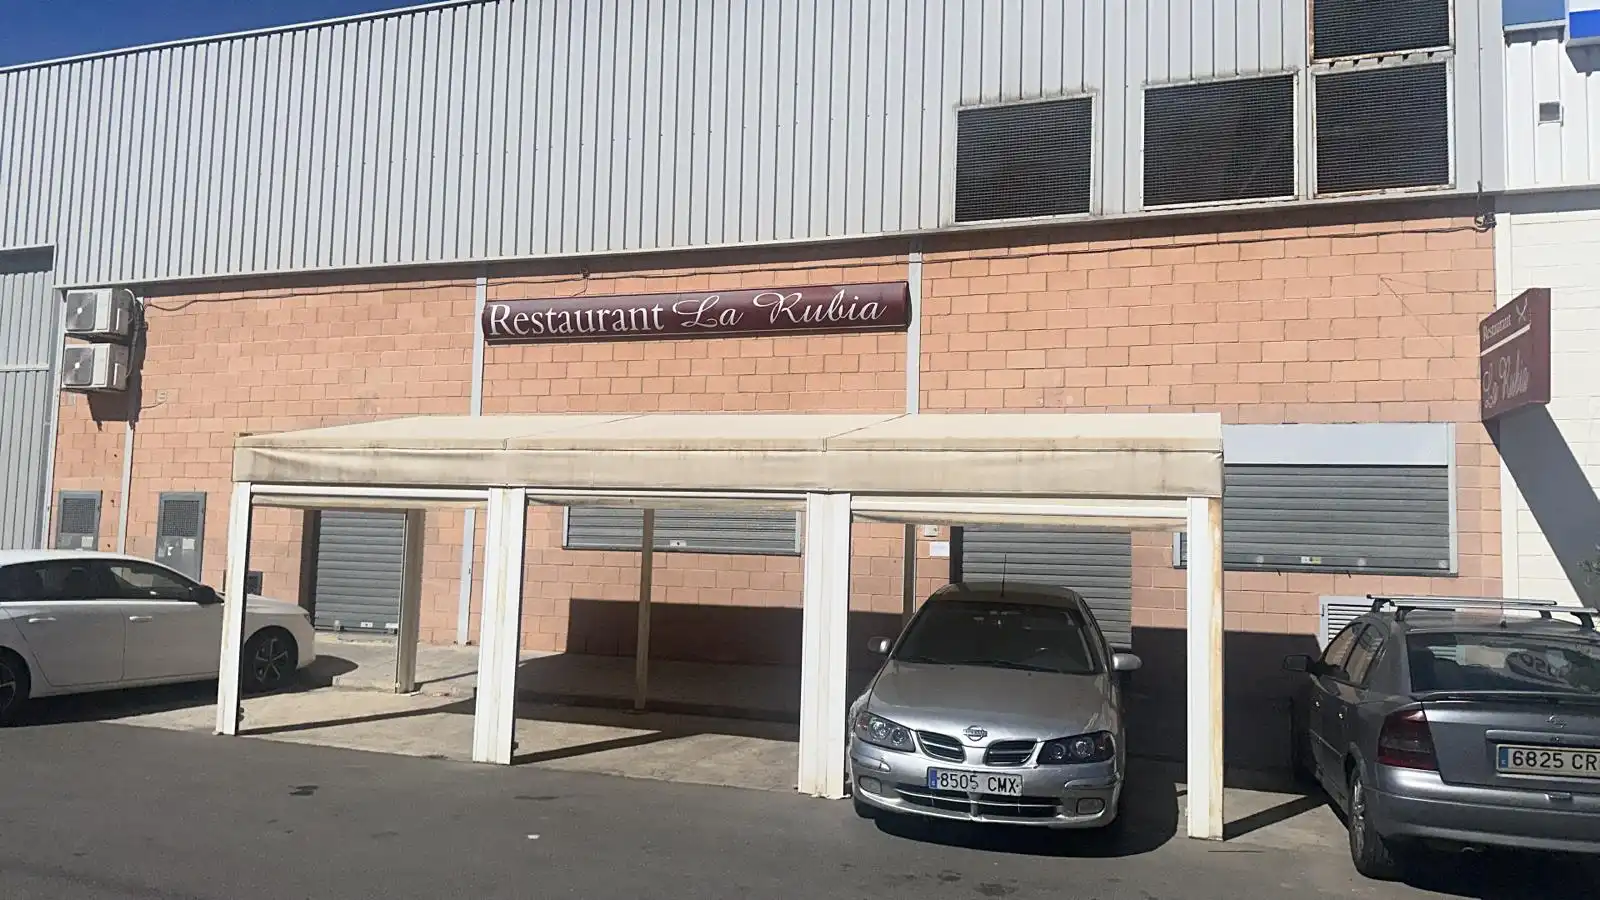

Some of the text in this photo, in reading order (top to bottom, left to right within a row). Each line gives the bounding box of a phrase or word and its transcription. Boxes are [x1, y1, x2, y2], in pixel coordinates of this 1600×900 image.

[489, 289, 889, 336] Restaurant La Rubia
[1512, 750, 1600, 771] 6825 CR
[940, 772, 1017, 794] 8505 CMX
